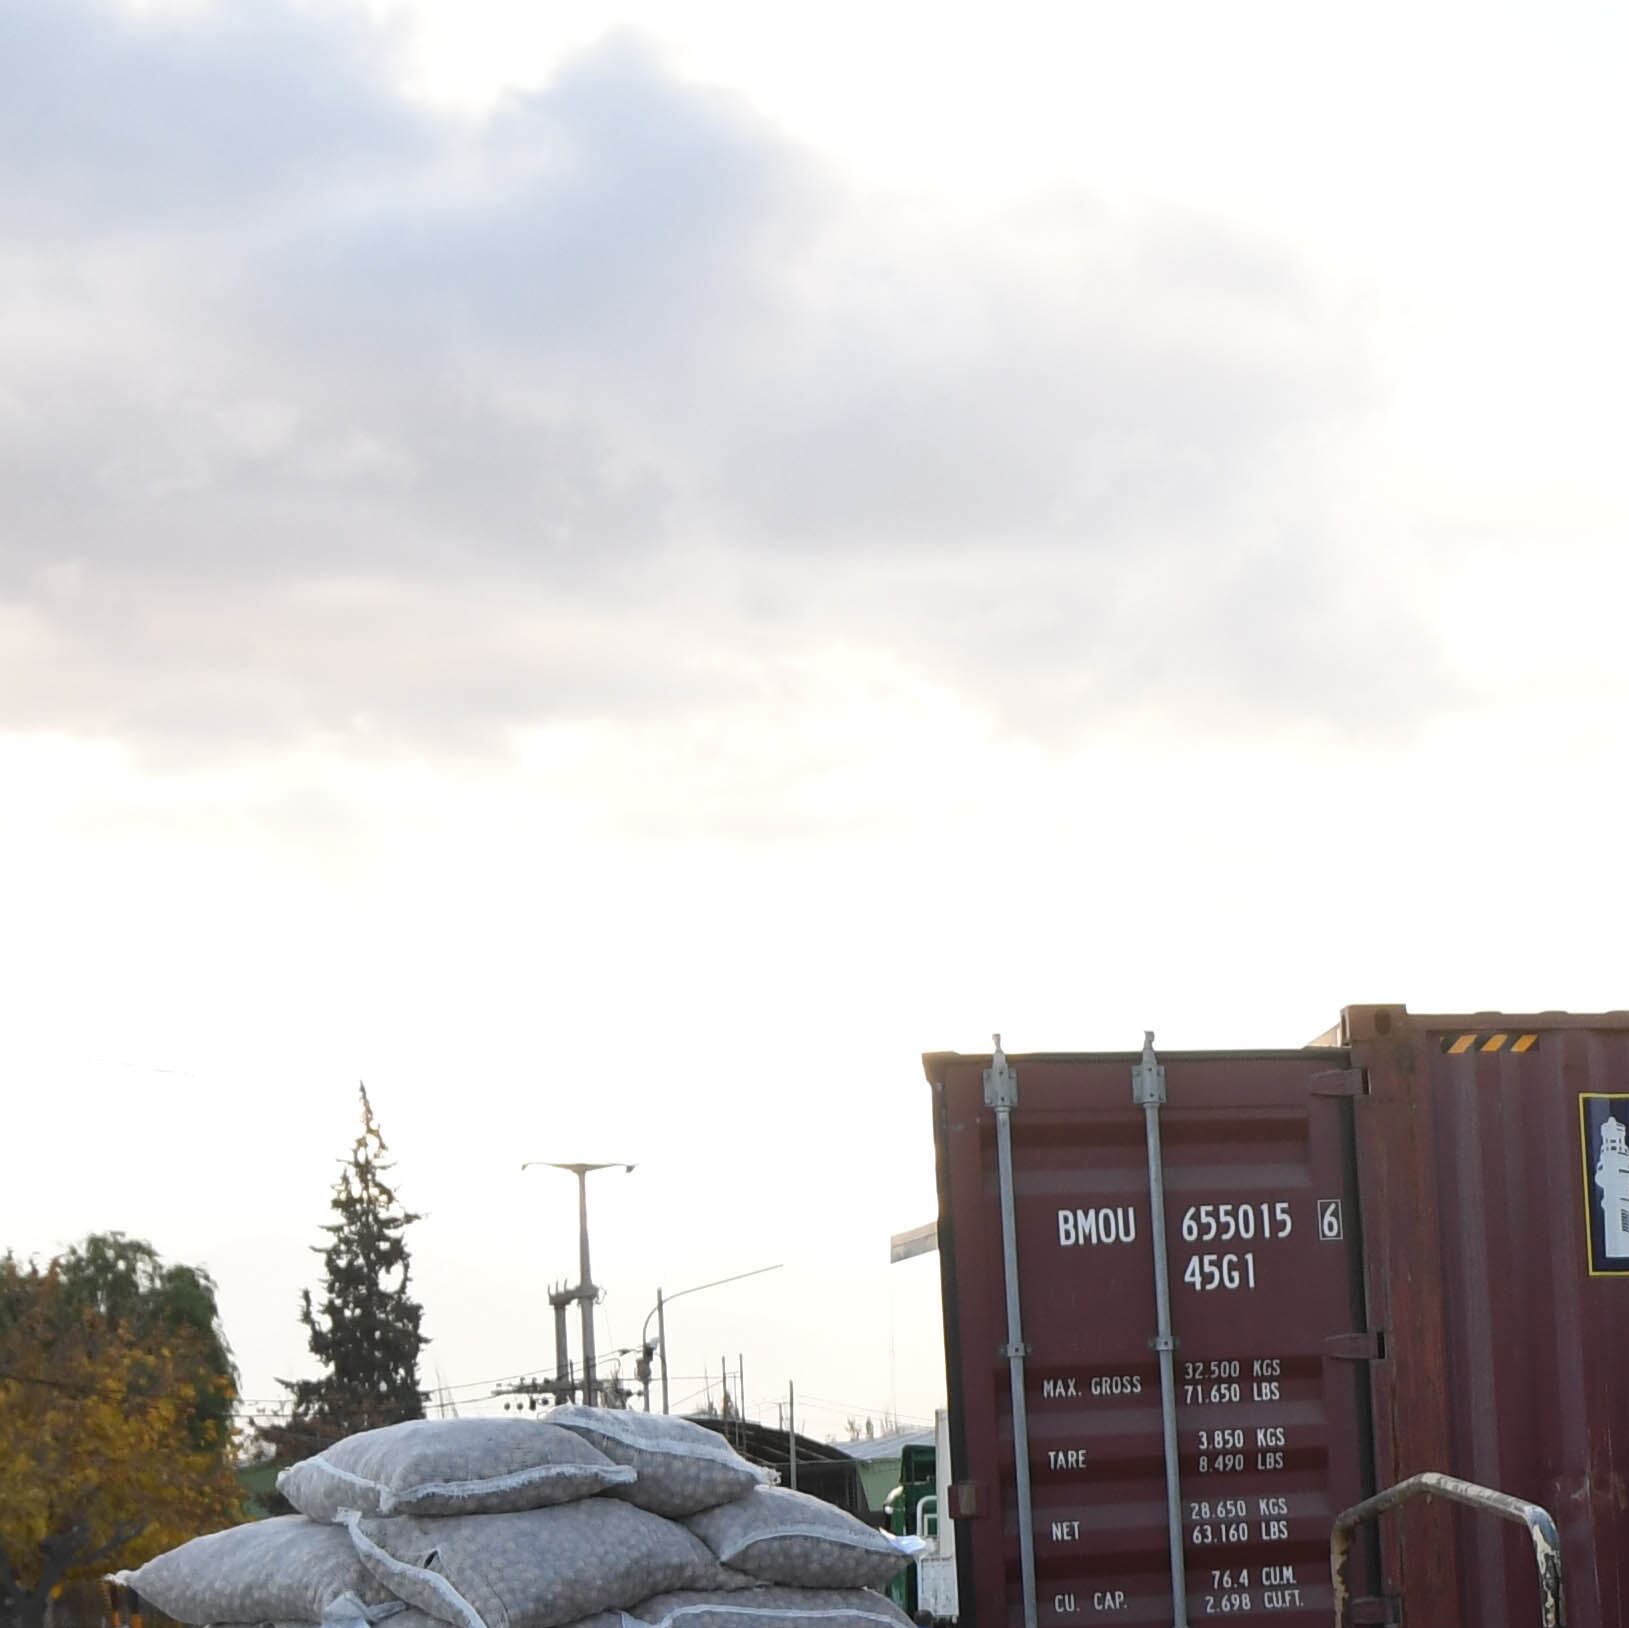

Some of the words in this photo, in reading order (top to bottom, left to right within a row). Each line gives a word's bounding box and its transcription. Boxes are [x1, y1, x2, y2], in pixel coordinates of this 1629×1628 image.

[1057, 1206, 1136, 1246] BMOU
[1181, 1202, 1292, 1241] 655015
[1184, 1253, 1256, 1290] 45G1
[1184, 1361, 1240, 1380] 32.500
[1253, 1359, 1281, 1377] KGS
[1043, 1379, 1083, 1399] MAX.
[1091, 1376, 1142, 1395] GROSS
[1184, 1383, 1240, 1404] 71.650
[1253, 1382, 1280, 1401] LBS
[1198, 1429, 1244, 1449] 3.850
[1257, 1427, 1285, 1447] KGS
[1048, 1450, 1087, 1470] TARE
[1199, 1454, 1244, 1472] 8.490
[1257, 1452, 1284, 1470] LBS
[1191, 1500, 1247, 1520] 28.650
[1259, 1498, 1288, 1516] KGS
[1052, 1521, 1081, 1542] NET
[1192, 1523, 1248, 1544] 63.160
[1261, 1521, 1288, 1540] LBS
[1212, 1569, 1249, 1589] 76.4
[1055, 1594, 1080, 1613] CU.
[1093, 1591, 1128, 1610] CAP.
[1205, 1594, 1251, 1614] 2.698
